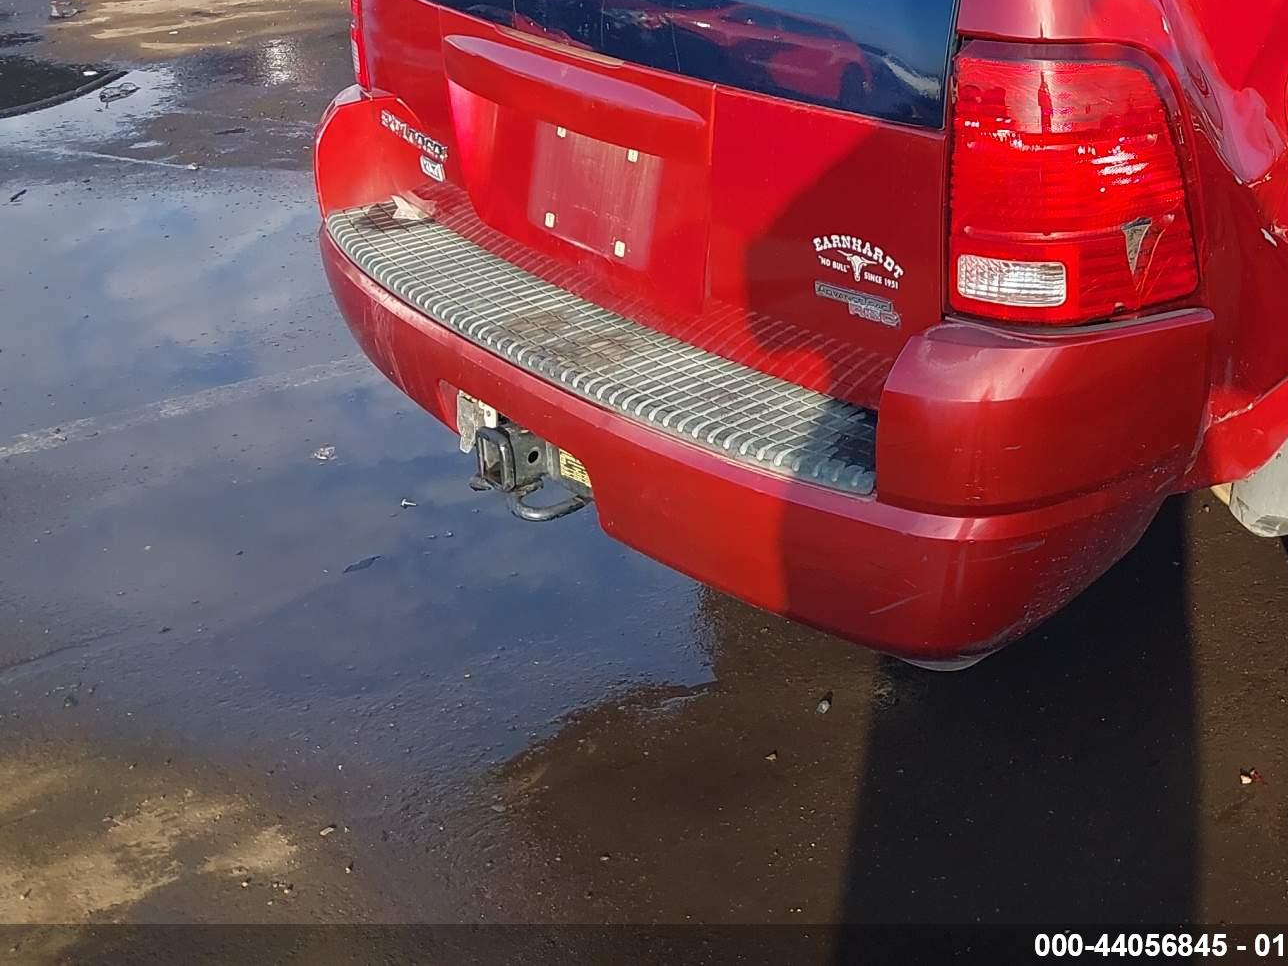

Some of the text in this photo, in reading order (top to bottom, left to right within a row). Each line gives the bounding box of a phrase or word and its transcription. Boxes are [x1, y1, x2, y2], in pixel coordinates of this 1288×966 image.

[813, 235, 904, 279] EARNHARDT
[863, 271, 899, 289] SINCE 1951
